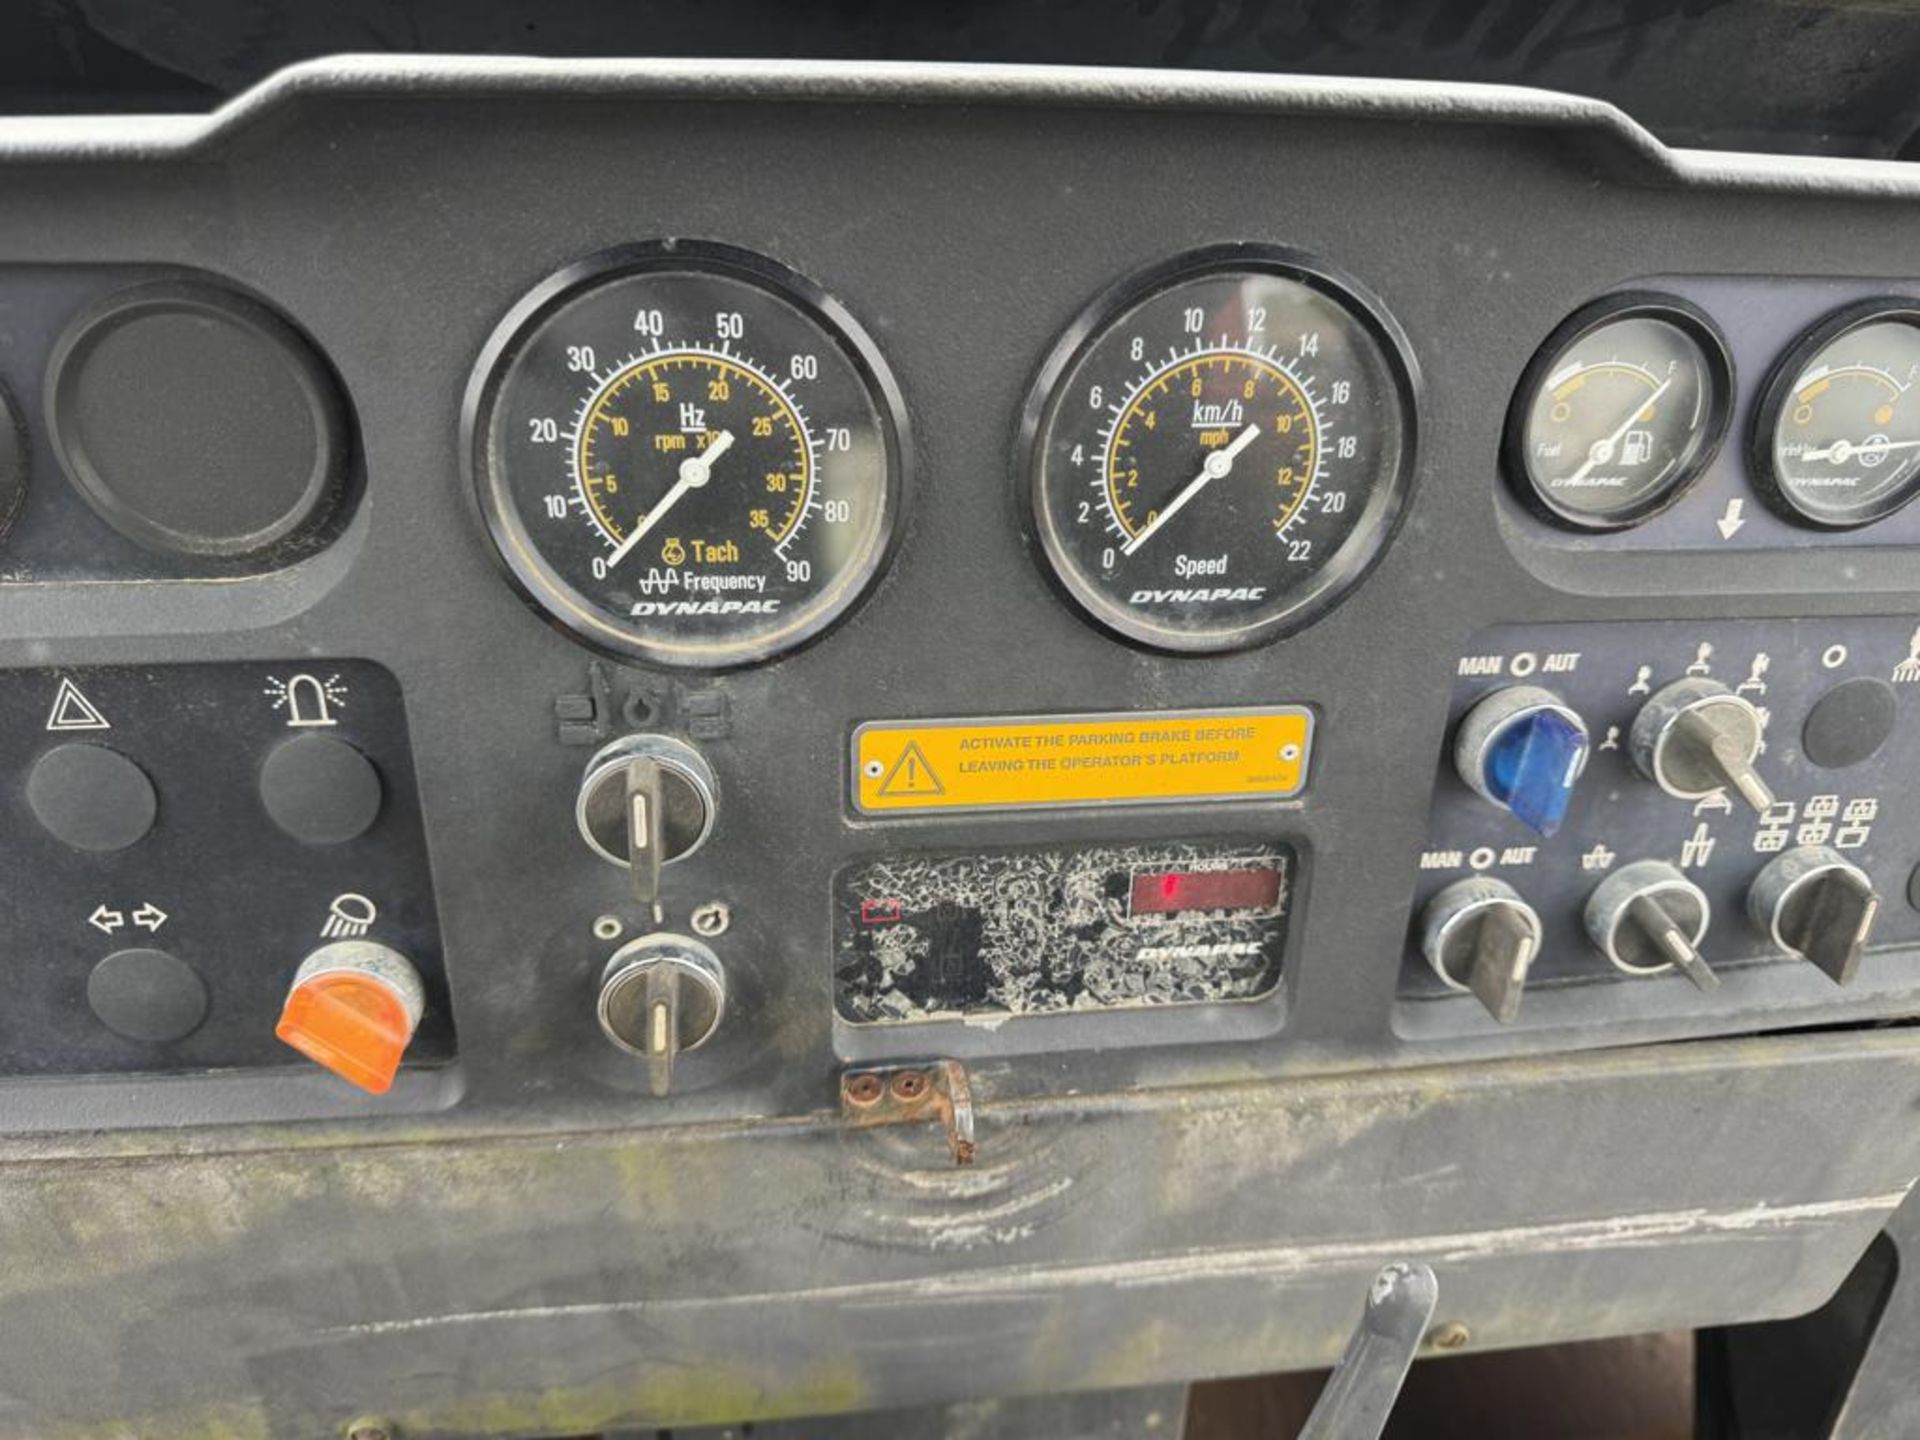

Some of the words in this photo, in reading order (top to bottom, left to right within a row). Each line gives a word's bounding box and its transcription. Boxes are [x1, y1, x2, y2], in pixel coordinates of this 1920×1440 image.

[634, 310, 663, 336] 40
[717, 313, 743, 339] 50
[1184, 309, 1203, 332] 10
[1248, 308, 1266, 332] 12
[1131, 337, 1144, 361] 8
[1299, 334, 1319, 357] 14
[567, 346, 595, 372] 30
[790, 355, 817, 380] 60
[652, 383, 670, 402] 15
[708, 381, 729, 401] 20
[1090, 386, 1102, 409] 6
[1332, 381, 1350, 404] 16
[679, 402, 706, 427] Hz
[1145, 411, 1156, 430] 4
[1193, 400, 1243, 422] km/h
[529, 419, 557, 443] 20
[610, 418, 628, 437] 10
[752, 417, 772, 437] 25
[1276, 414, 1291, 433] 10
[655, 434, 686, 454] rpm
[827, 429, 850, 451] 70
[1200, 427, 1230, 448] mph
[1337, 436, 1356, 458] 18
[1071, 444, 1084, 467] 4
[605, 474, 617, 493] 5
[766, 473, 786, 492] 30
[1127, 469, 1138, 488] 2
[1277, 468, 1291, 485] 12
[544, 495, 566, 518] 10
[825, 501, 848, 523] 80
[1078, 502, 1089, 523] 2
[1321, 492, 1345, 513] 20
[749, 510, 769, 528] 35
[691, 540, 739, 562] Tach
[1103, 548, 1115, 569] 0
[1287, 541, 1311, 561] 22
[592, 557, 607, 580] 0
[786, 560, 811, 582] 90
[1175, 554, 1228, 578] Speed
[683, 571, 766, 593] Frequency
[1130, 587, 1266, 604] DYNAPAC
[630, 599, 780, 616] DYNAPAC
[1458, 656, 1503, 676] MAN
[1542, 653, 1581, 673] AUT
[960, 736, 1032, 751] ACTIVATE
[1035, 734, 1064, 748] THE
[1068, 731, 1134, 747] PARKING
[1139, 729, 1191, 744] BRAKE
[1195, 727, 1257, 742] BEFORE
[959, 759, 1024, 773] LEAVING
[1028, 758, 1056, 771] THE
[1160, 750, 1241, 766] PLATFORM
[1420, 850, 1463, 870] MAN
[1499, 846, 1538, 865] AUT
